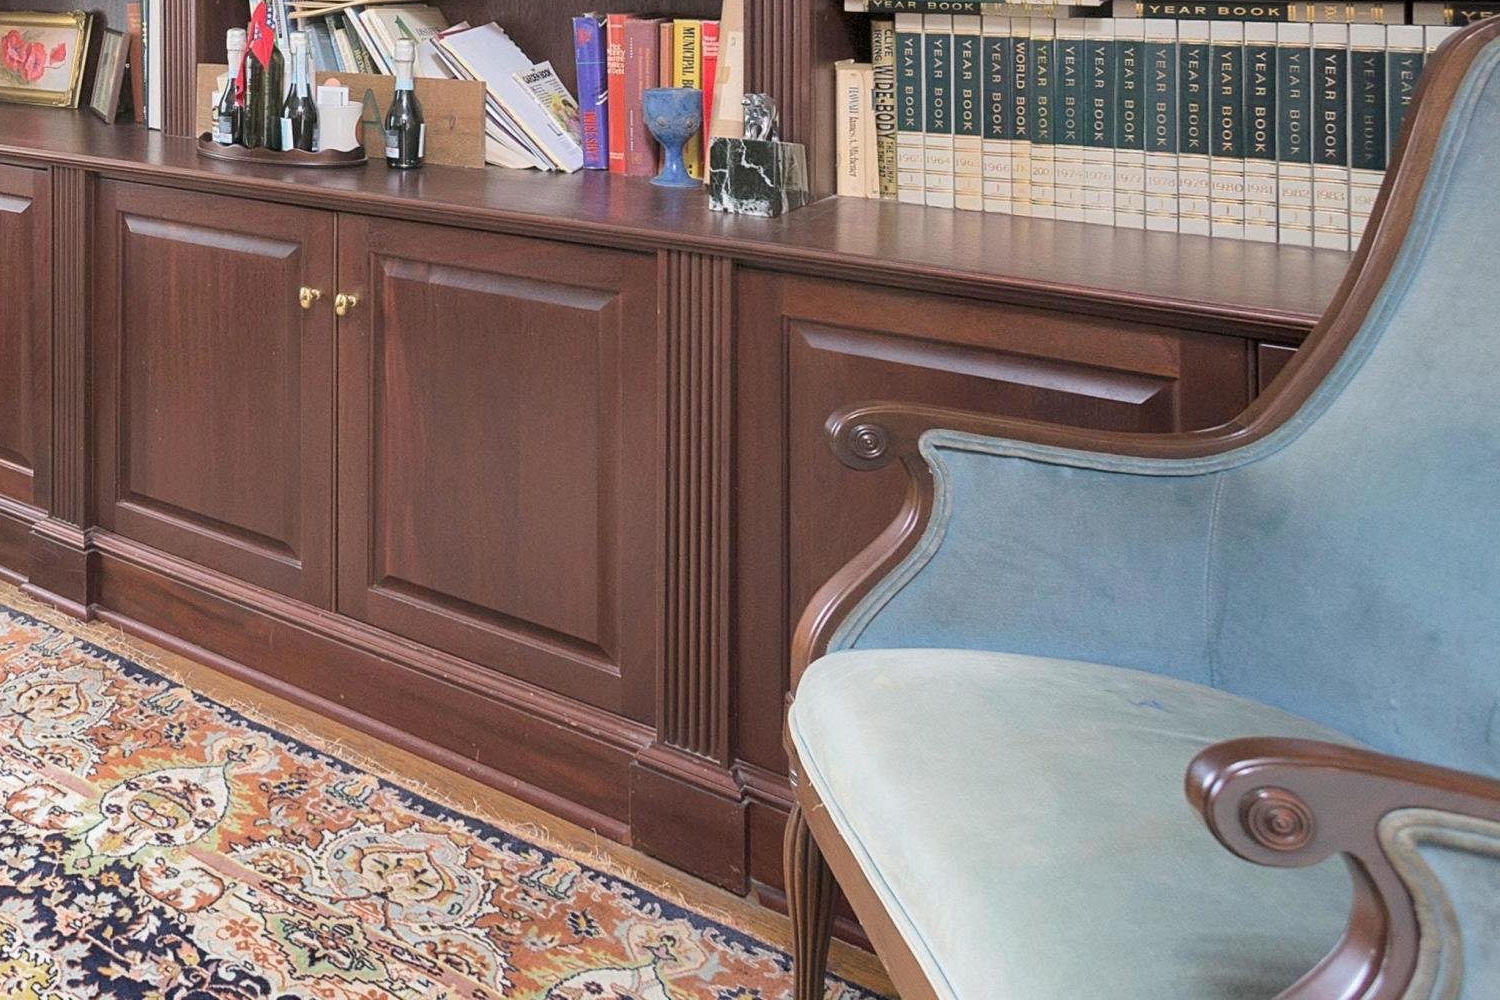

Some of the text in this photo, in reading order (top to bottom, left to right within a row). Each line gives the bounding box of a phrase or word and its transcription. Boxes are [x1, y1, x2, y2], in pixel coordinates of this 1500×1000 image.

[682, 26, 696, 76] MUNICIPAL
[873, 0, 975, 11] YEAR BOOK
[874, 29, 882, 62] IRVING
[884, 28, 894, 58] CLIVE
[1149, 4, 1281, 17] YEAR BOOK
[903, 38, 915, 127] YEAR BOOK
[933, 39, 944, 129] YEAR BOOK
[962, 39, 973, 130] YEAR BOOK
[991, 42, 1003, 134] YEAR BOOK
[1015, 42, 1026, 136] WORLD BOOK
[1037, 45, 1049, 139] YEAR BOOK
[1065, 46, 1076, 140] YEAR BOOK
[1094, 46, 1105, 141] YEAR BOOK
[1124, 48, 1135, 143] YEAR BOOK
[1156, 49, 1168, 147] YEAR BOOK
[1188, 49, 1200, 148] YEAR BOOK
[1221, 51, 1233, 151] YEAR BOOK
[1255, 51, 1266, 152] YEAR BOOK
[1289, 53, 1300, 156] YEAR BOOK
[1324, 54, 1337, 159] YEAR BOOK
[1363, 56, 1375, 104] YEAR
[1212, 181, 1244, 193] 1980
